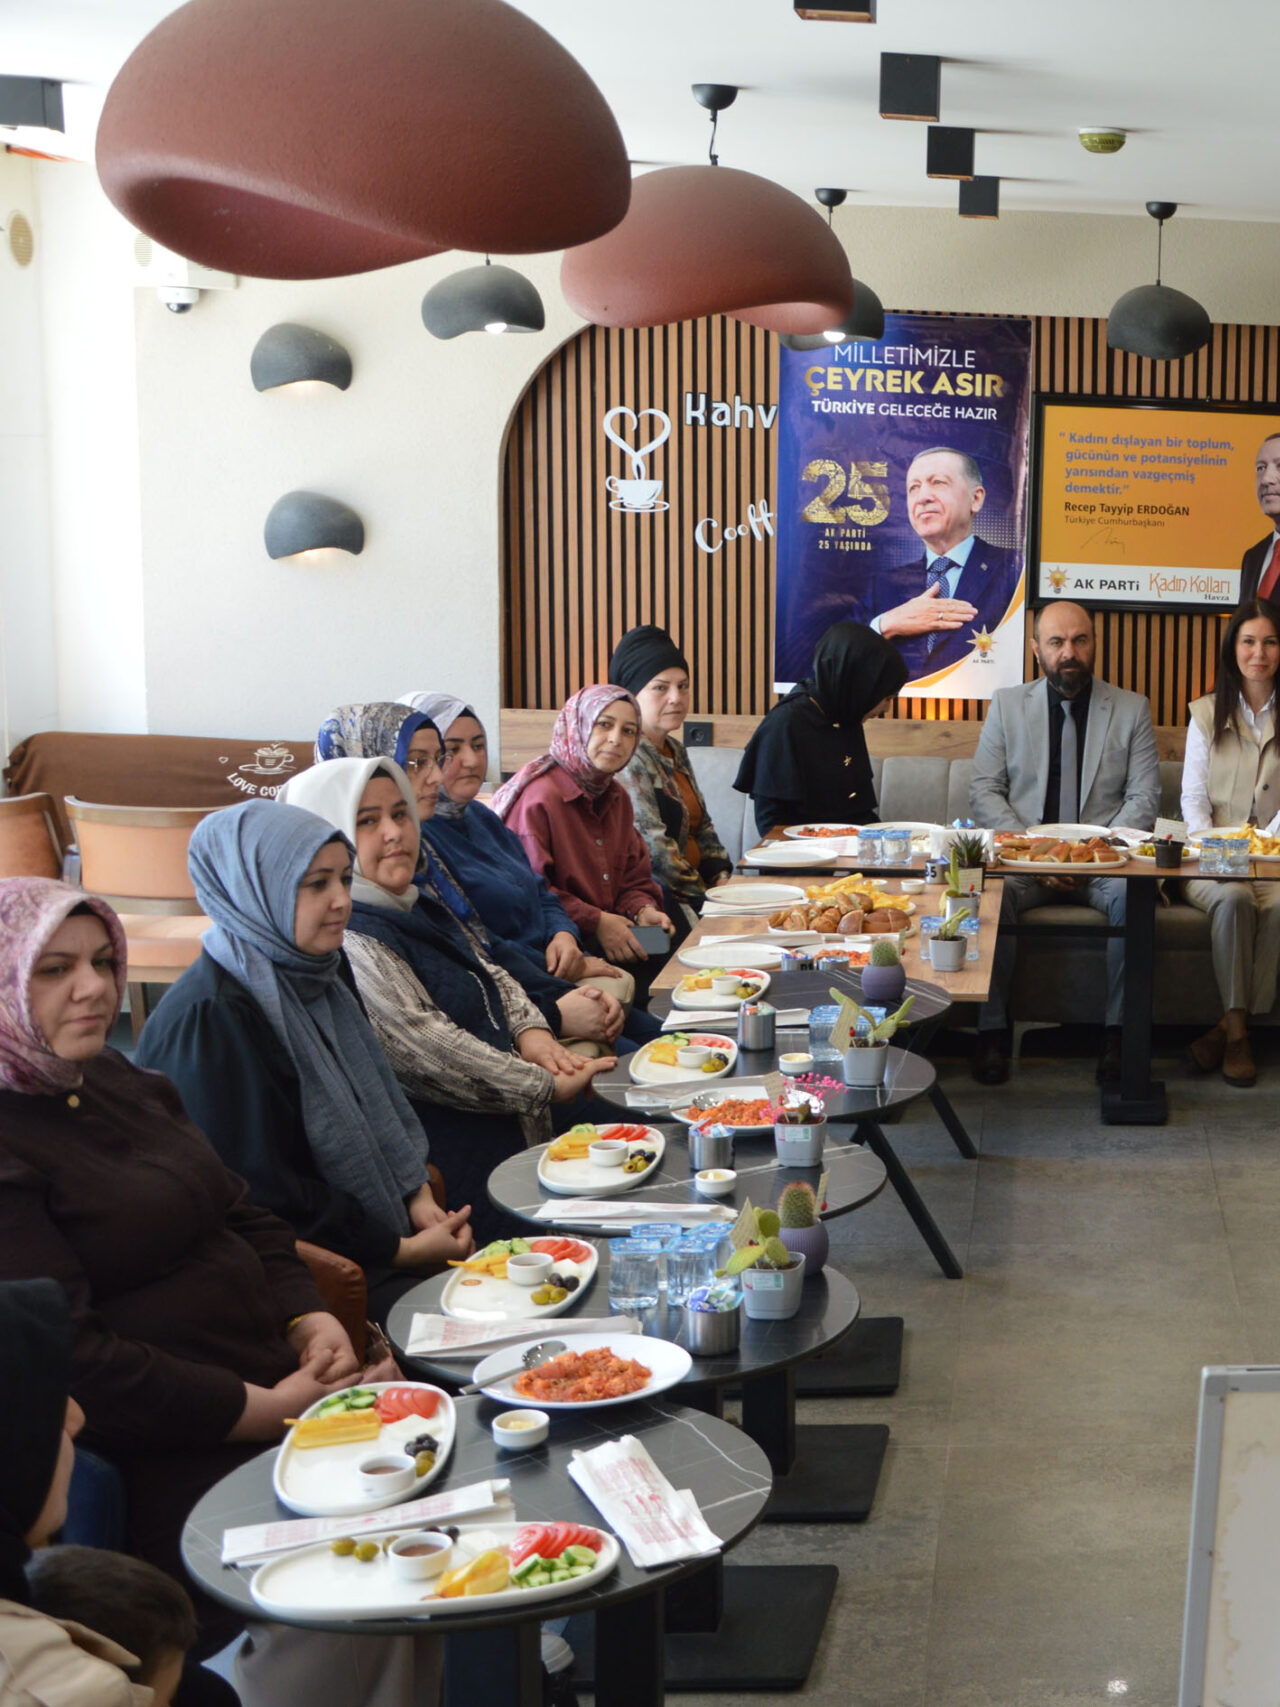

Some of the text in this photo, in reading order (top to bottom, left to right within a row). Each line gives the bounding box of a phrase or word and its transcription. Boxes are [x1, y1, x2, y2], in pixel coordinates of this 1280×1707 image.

[834, 343, 976, 369] MİLLETİMİZLE
[805, 366, 1004, 398] ÇEYREK ASIR
[685, 392, 777, 429] Kahv
[811, 399, 997, 420] TÜRKİYE GELECEĞE HAZIR
[1069, 432, 1108, 445] Kadını
[1112, 434, 1162, 448] dışlayan
[1166, 436, 1183, 448] bir
[1187, 438, 1235, 452] toplum,
[1065, 450, 1228, 468] gücünün ve potansiyelinin
[1065, 466, 1196, 485] yarısından vazgeçmiş
[802, 458, 890, 526] 25
[1064, 501, 1190, 517] Recep Tayyip ERDOĞAN
[1064, 514, 1165, 529] Türkiye Cumhurbaşkanı
[818, 540, 831, 551] 25
[1074, 578, 1095, 590] AK
[1150, 572, 1231, 598] Kadın Kolları
[1204, 593, 1230, 601] Havza
[226, 772, 258, 795] LOVE
